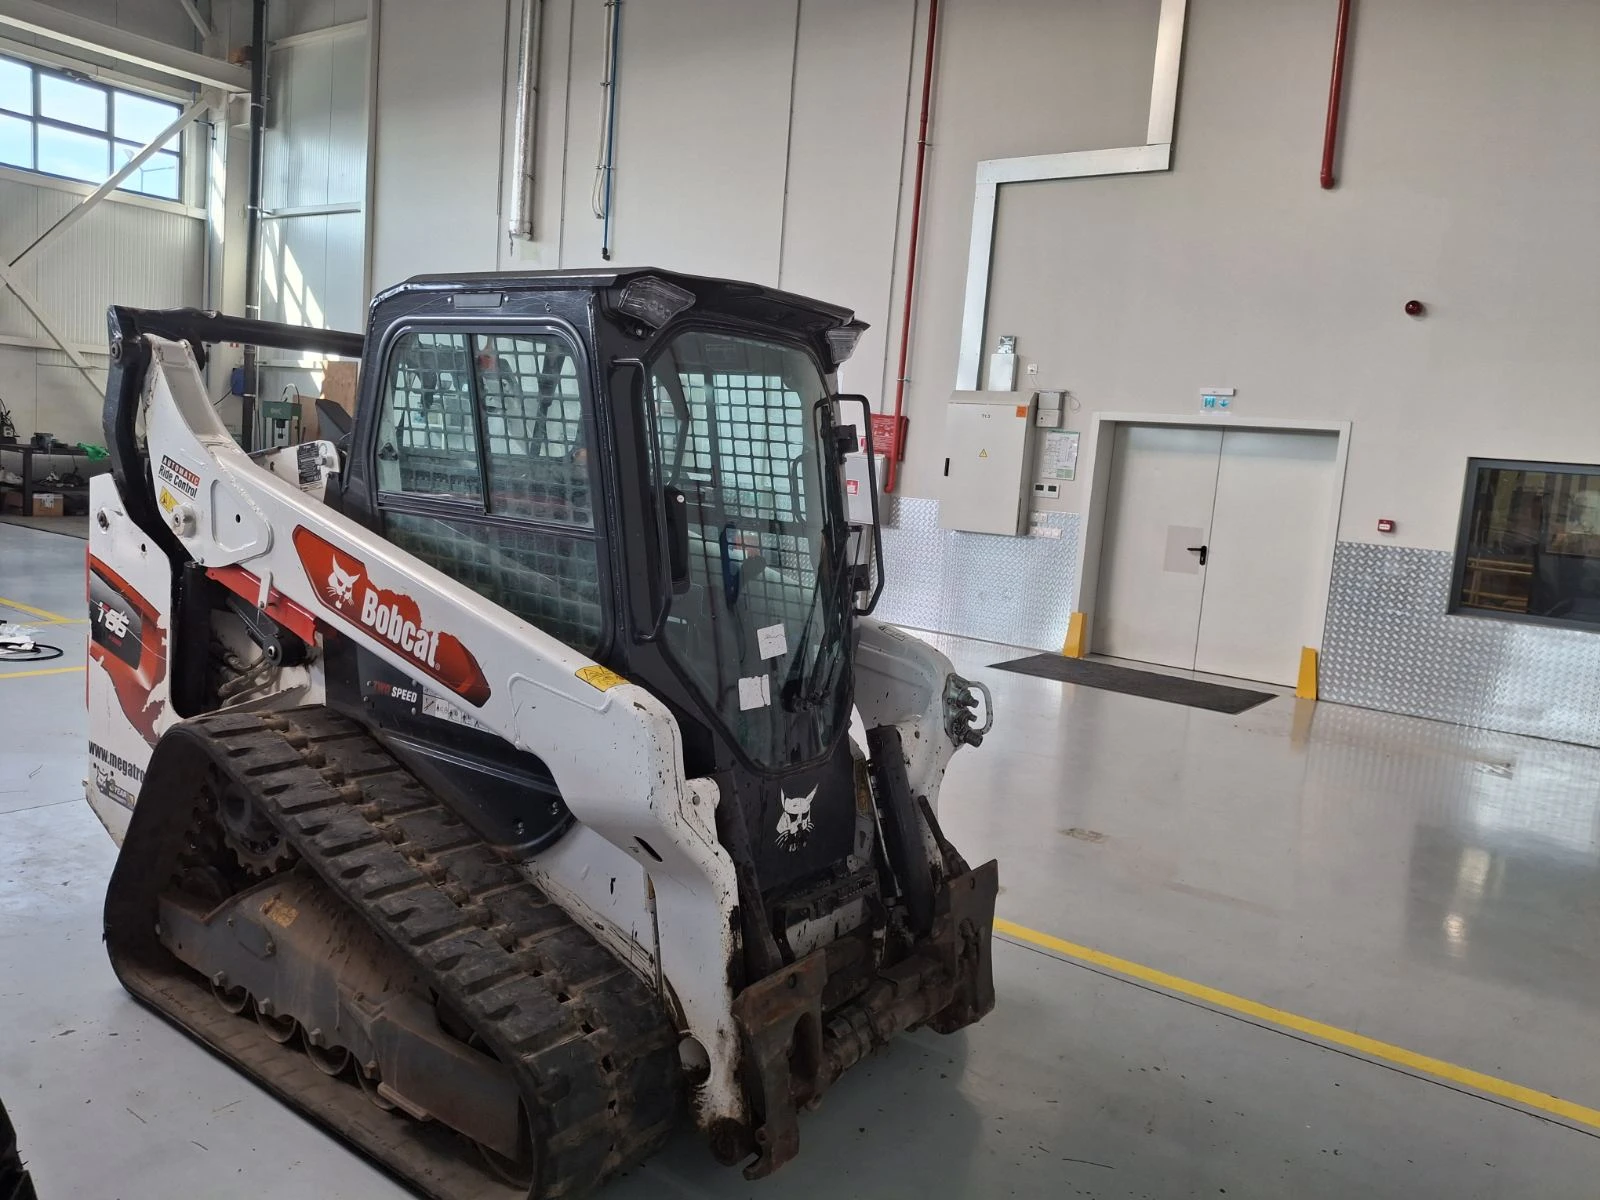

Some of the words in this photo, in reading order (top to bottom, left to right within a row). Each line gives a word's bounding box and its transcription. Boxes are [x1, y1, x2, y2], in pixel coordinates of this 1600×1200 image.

[159, 465, 173, 482] Ride
[174, 475, 198, 498] Control
[161, 456, 199, 486] AUTOMATIC
[361, 588, 439, 668] Bobcat
[391, 687, 418, 703] SPEED
